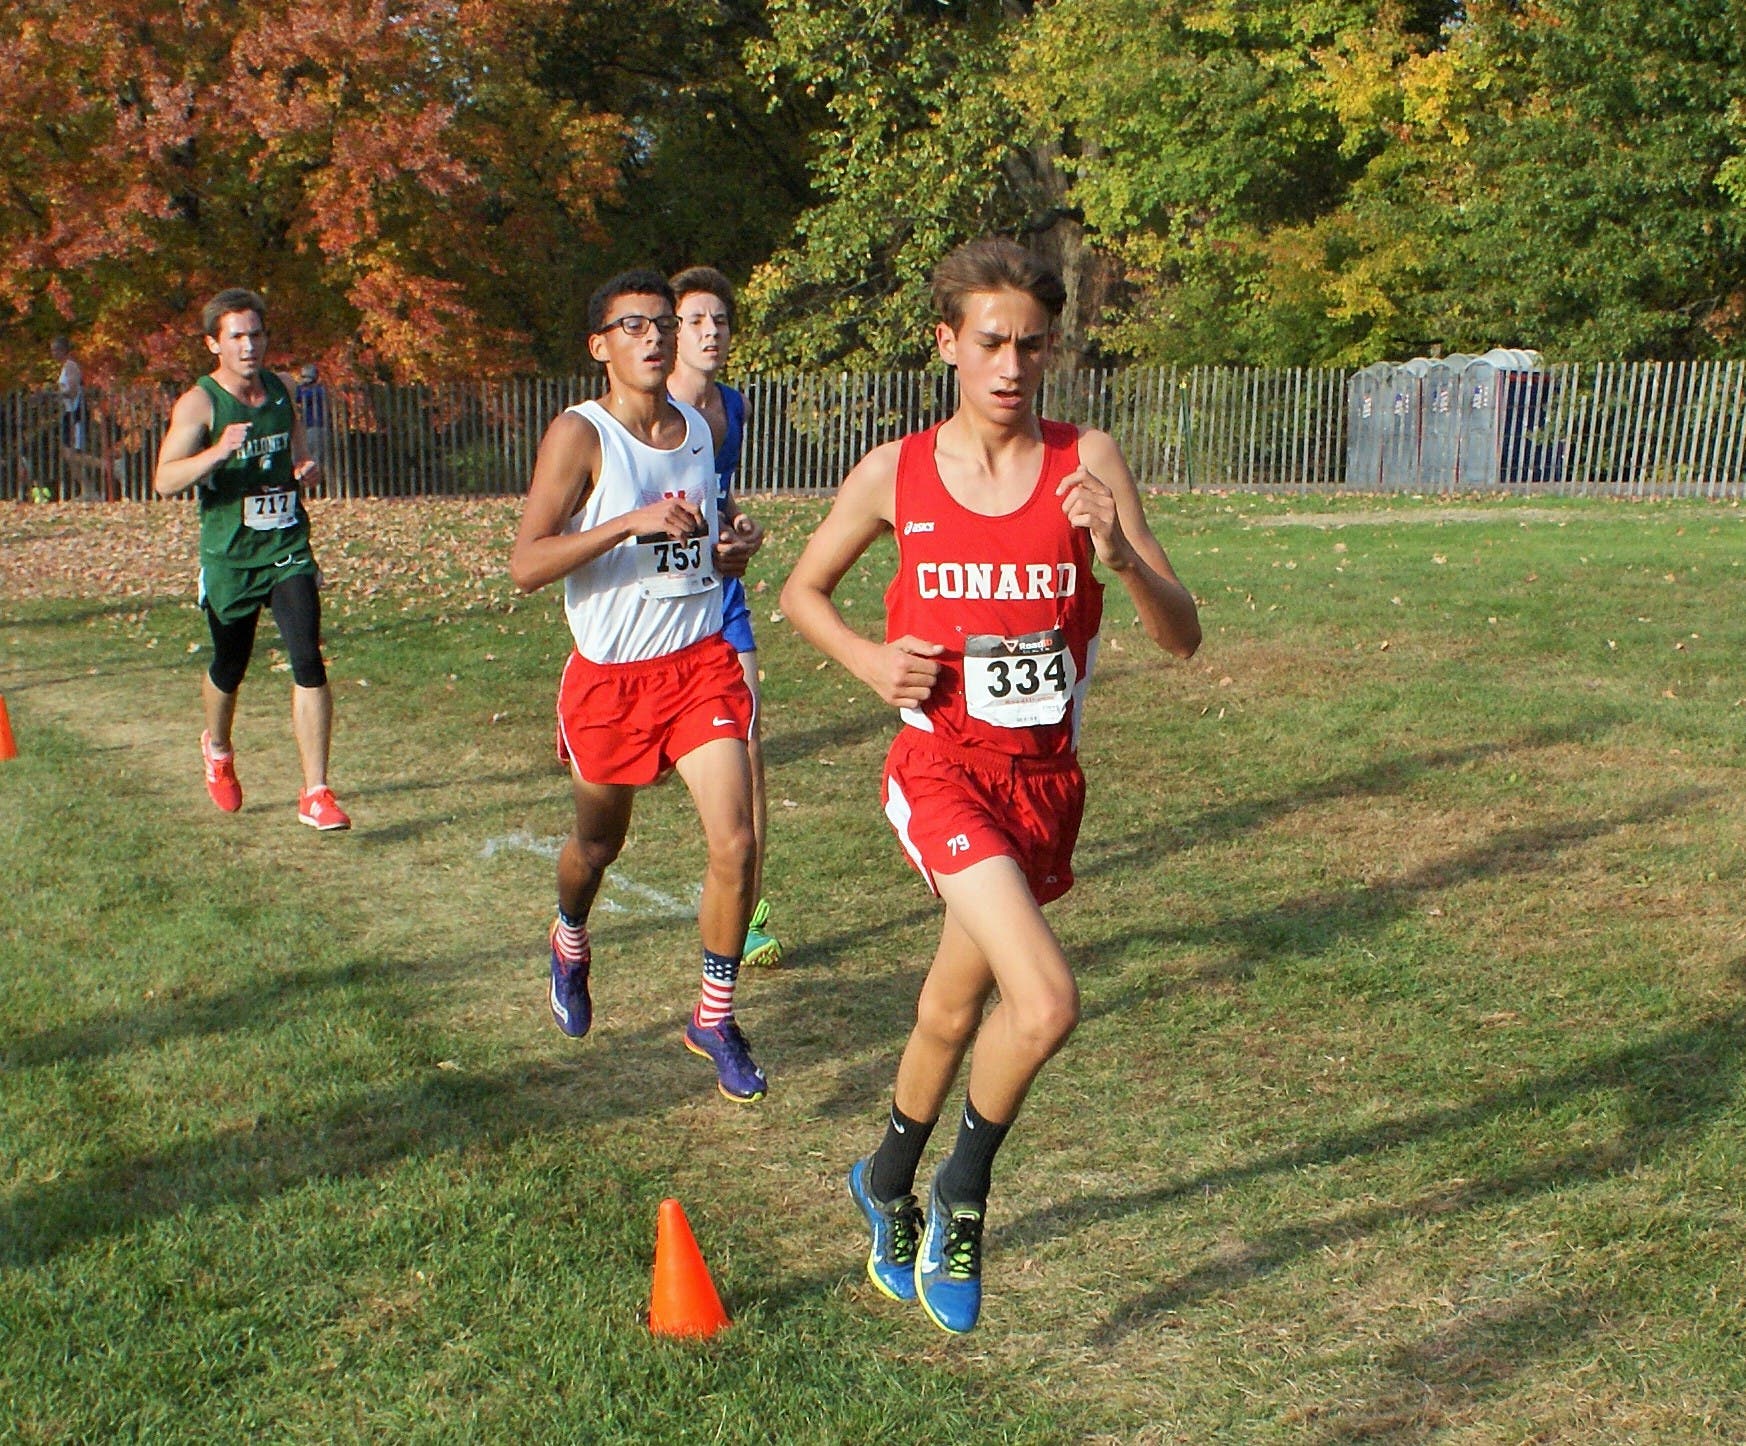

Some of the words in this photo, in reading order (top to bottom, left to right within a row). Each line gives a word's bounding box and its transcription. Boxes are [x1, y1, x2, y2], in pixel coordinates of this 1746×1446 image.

[255, 495, 288, 514] 717
[654, 540, 701, 573] 753
[916, 562, 1077, 600] CONARD
[987, 654, 1067, 698] 334
[946, 833, 971, 857] 79
